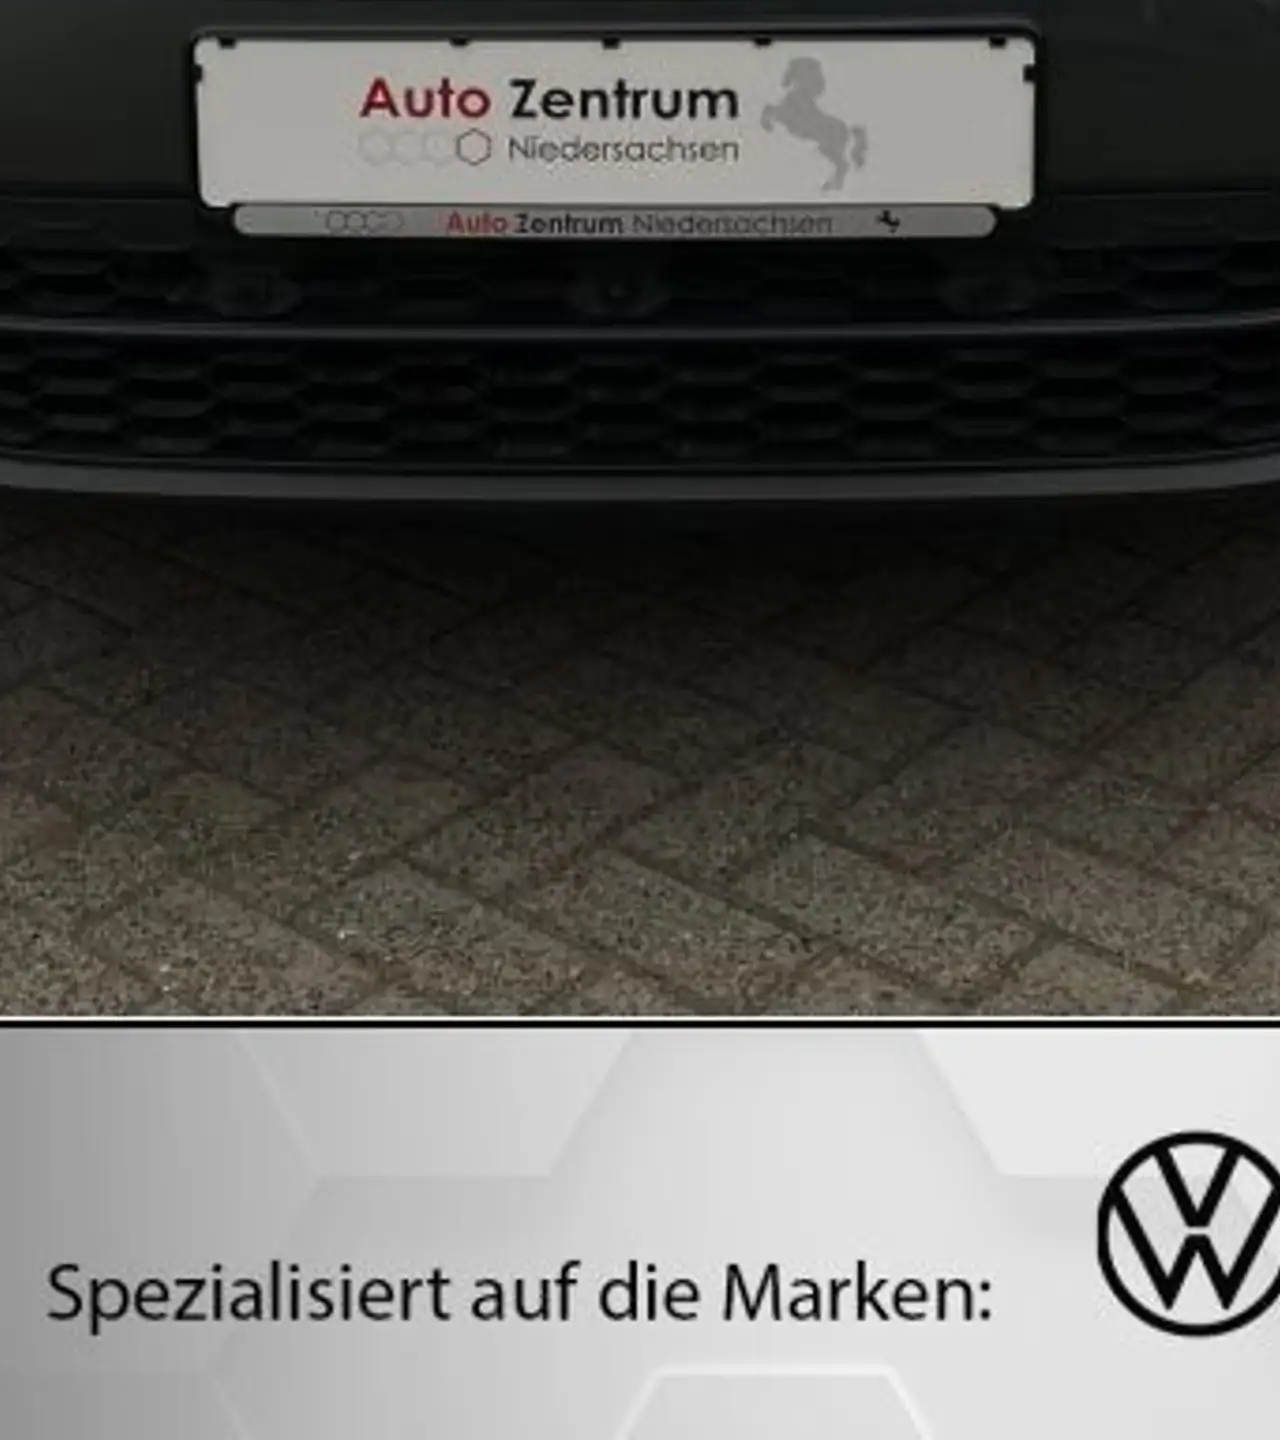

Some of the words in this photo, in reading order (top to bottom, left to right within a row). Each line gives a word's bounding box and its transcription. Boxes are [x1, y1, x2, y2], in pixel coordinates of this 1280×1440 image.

[359, 76, 490, 119] Auto
[509, 77, 739, 121] Zentrum
[508, 134, 739, 164] Niedersachsen
[444, 209, 508, 235] Auto
[514, 210, 623, 236] Zentrum
[631, 210, 834, 236] Niedersachsen
